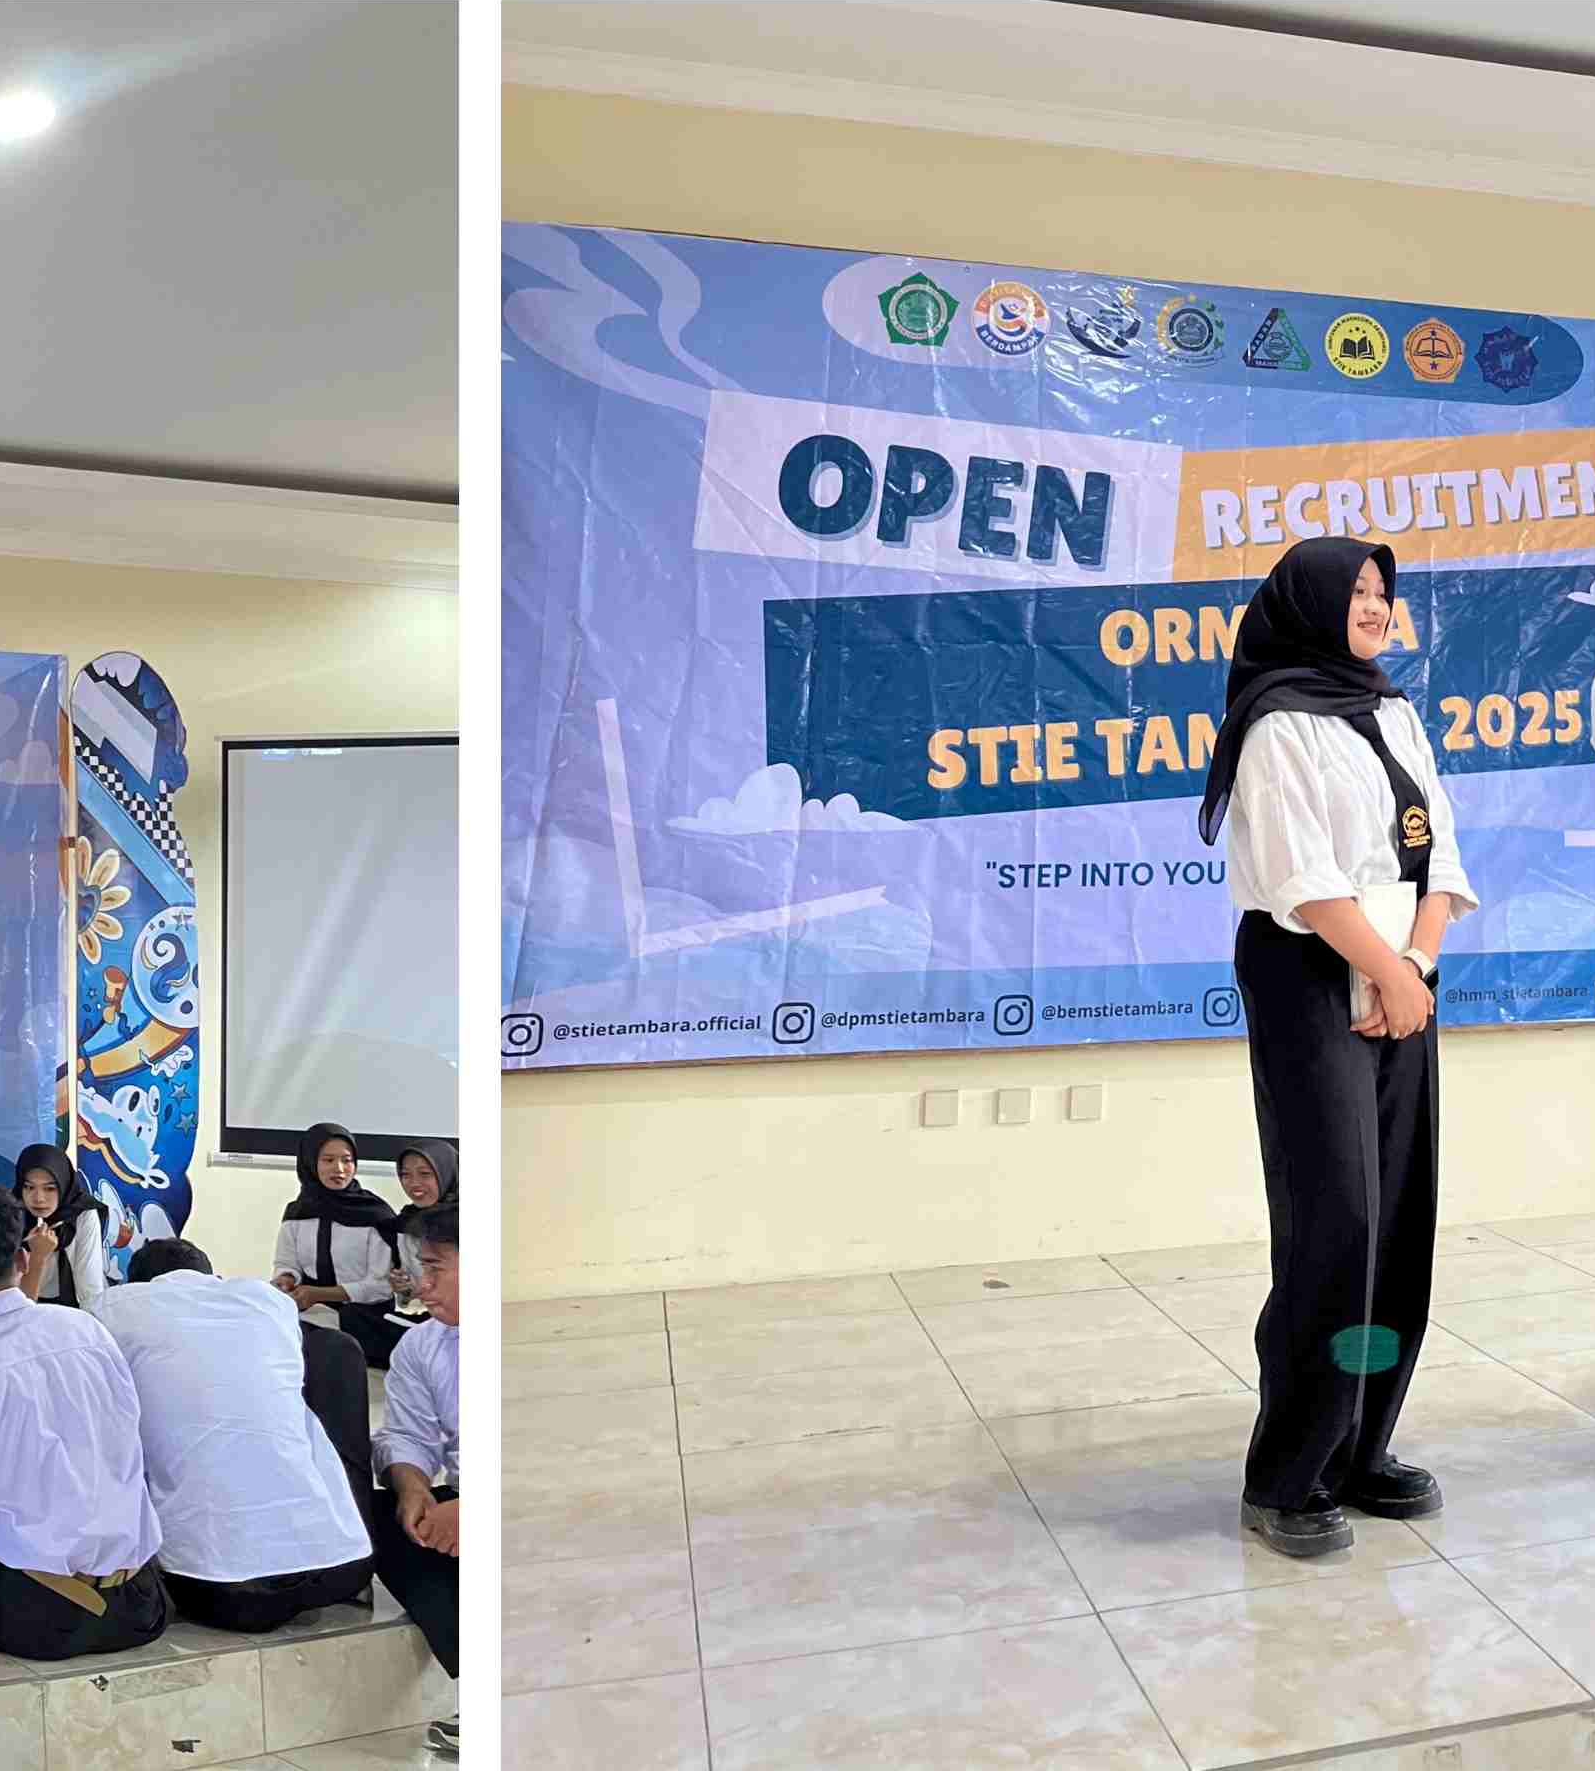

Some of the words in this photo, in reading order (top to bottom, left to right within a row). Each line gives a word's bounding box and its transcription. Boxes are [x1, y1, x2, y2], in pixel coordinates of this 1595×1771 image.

[779, 434, 1113, 570] OPEN
[1099, 597, 1420, 666] ORMA
[927, 722, 1080, 789] STIE
[1439, 689, 1583, 751] 2025
[985, 861, 1072, 888] "STEP
[1081, 862, 1154, 887] INTO
[1163, 860, 1226, 885] YOU
[821, 1007, 985, 1029] @dpmstietambara
[1041, 1001, 1193, 1021] @bemstietambara
[553, 1014, 762, 1040] @stietambara.official
